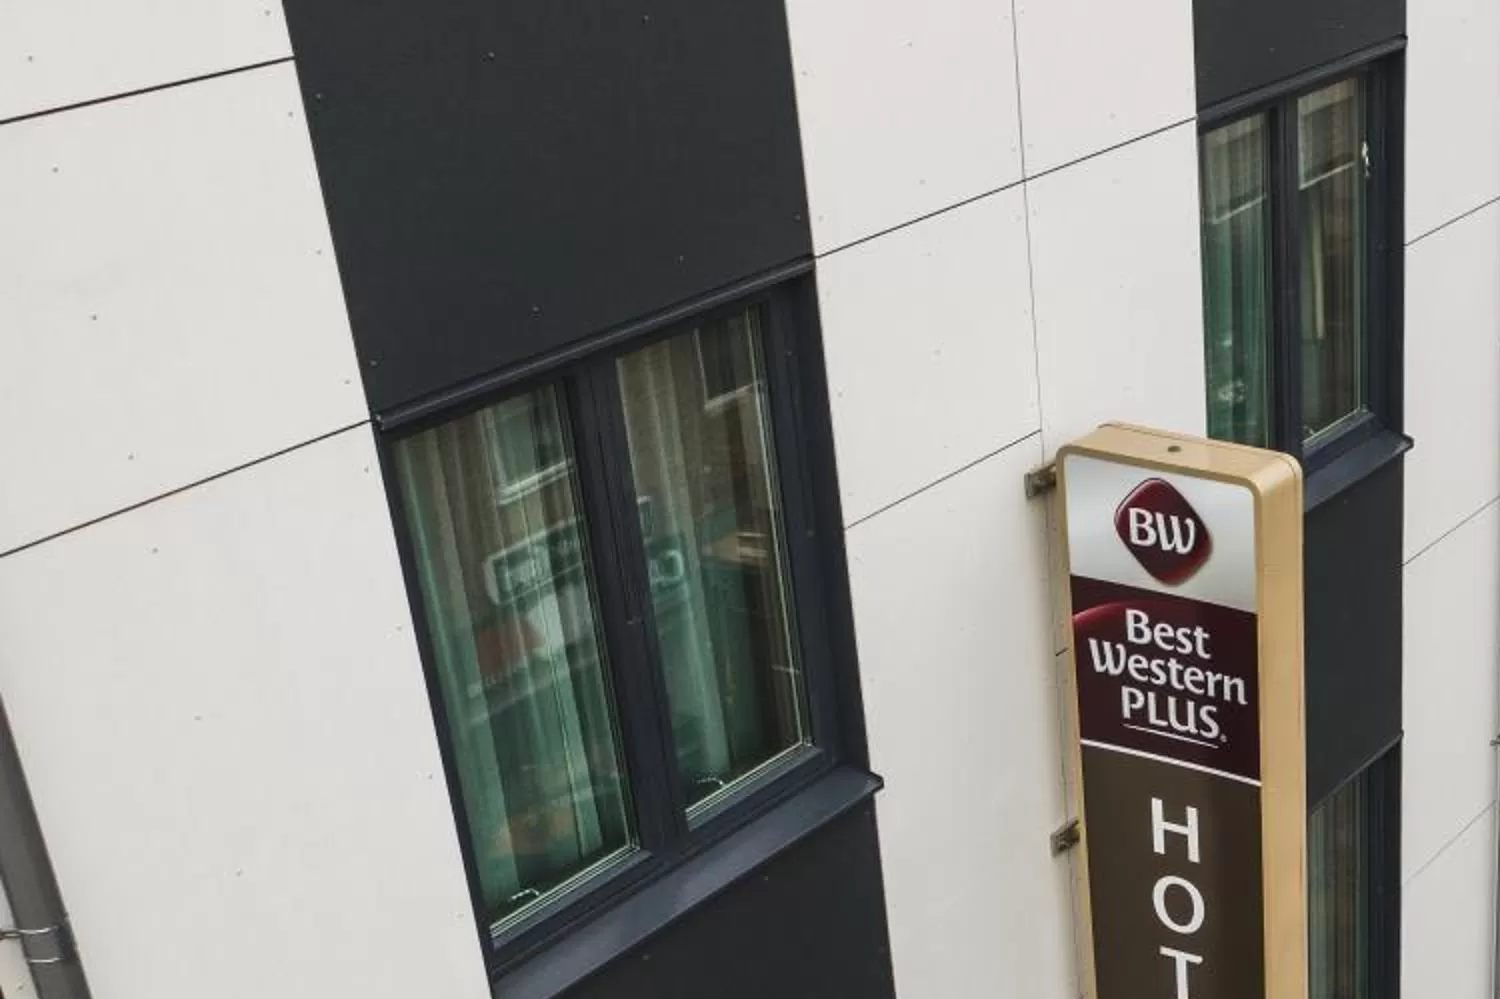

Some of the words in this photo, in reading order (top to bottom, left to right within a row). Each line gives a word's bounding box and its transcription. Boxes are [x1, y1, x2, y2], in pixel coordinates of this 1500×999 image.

[1127, 507, 1196, 556] BW
[1125, 608, 1211, 660] Best
[1088, 637, 1249, 705] Western
[1120, 685, 1221, 740] PLUS
